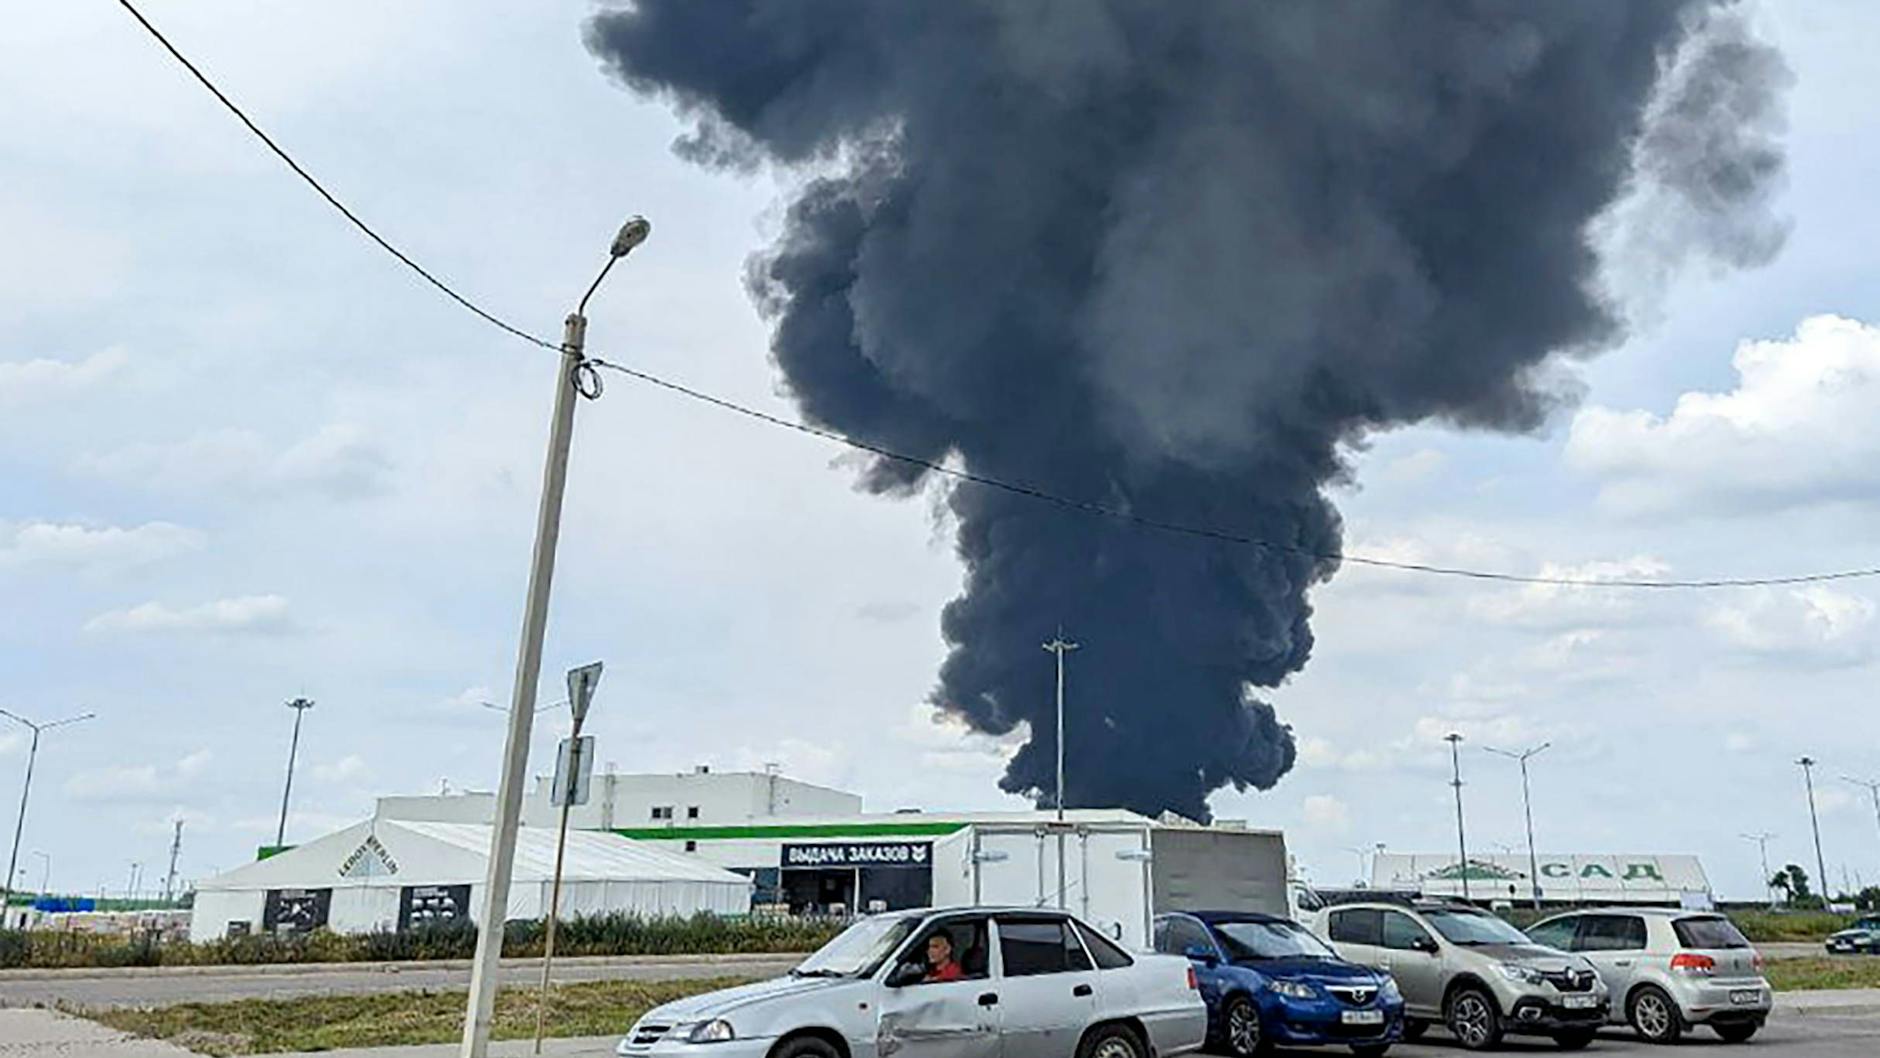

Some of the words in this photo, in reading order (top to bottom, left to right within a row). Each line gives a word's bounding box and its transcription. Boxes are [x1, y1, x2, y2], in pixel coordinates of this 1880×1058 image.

[789, 847, 845, 863] ВЫДАЧА
[848, 845, 909, 861] ЗАКАЗОВ
[1541, 863, 1663, 881] САД
